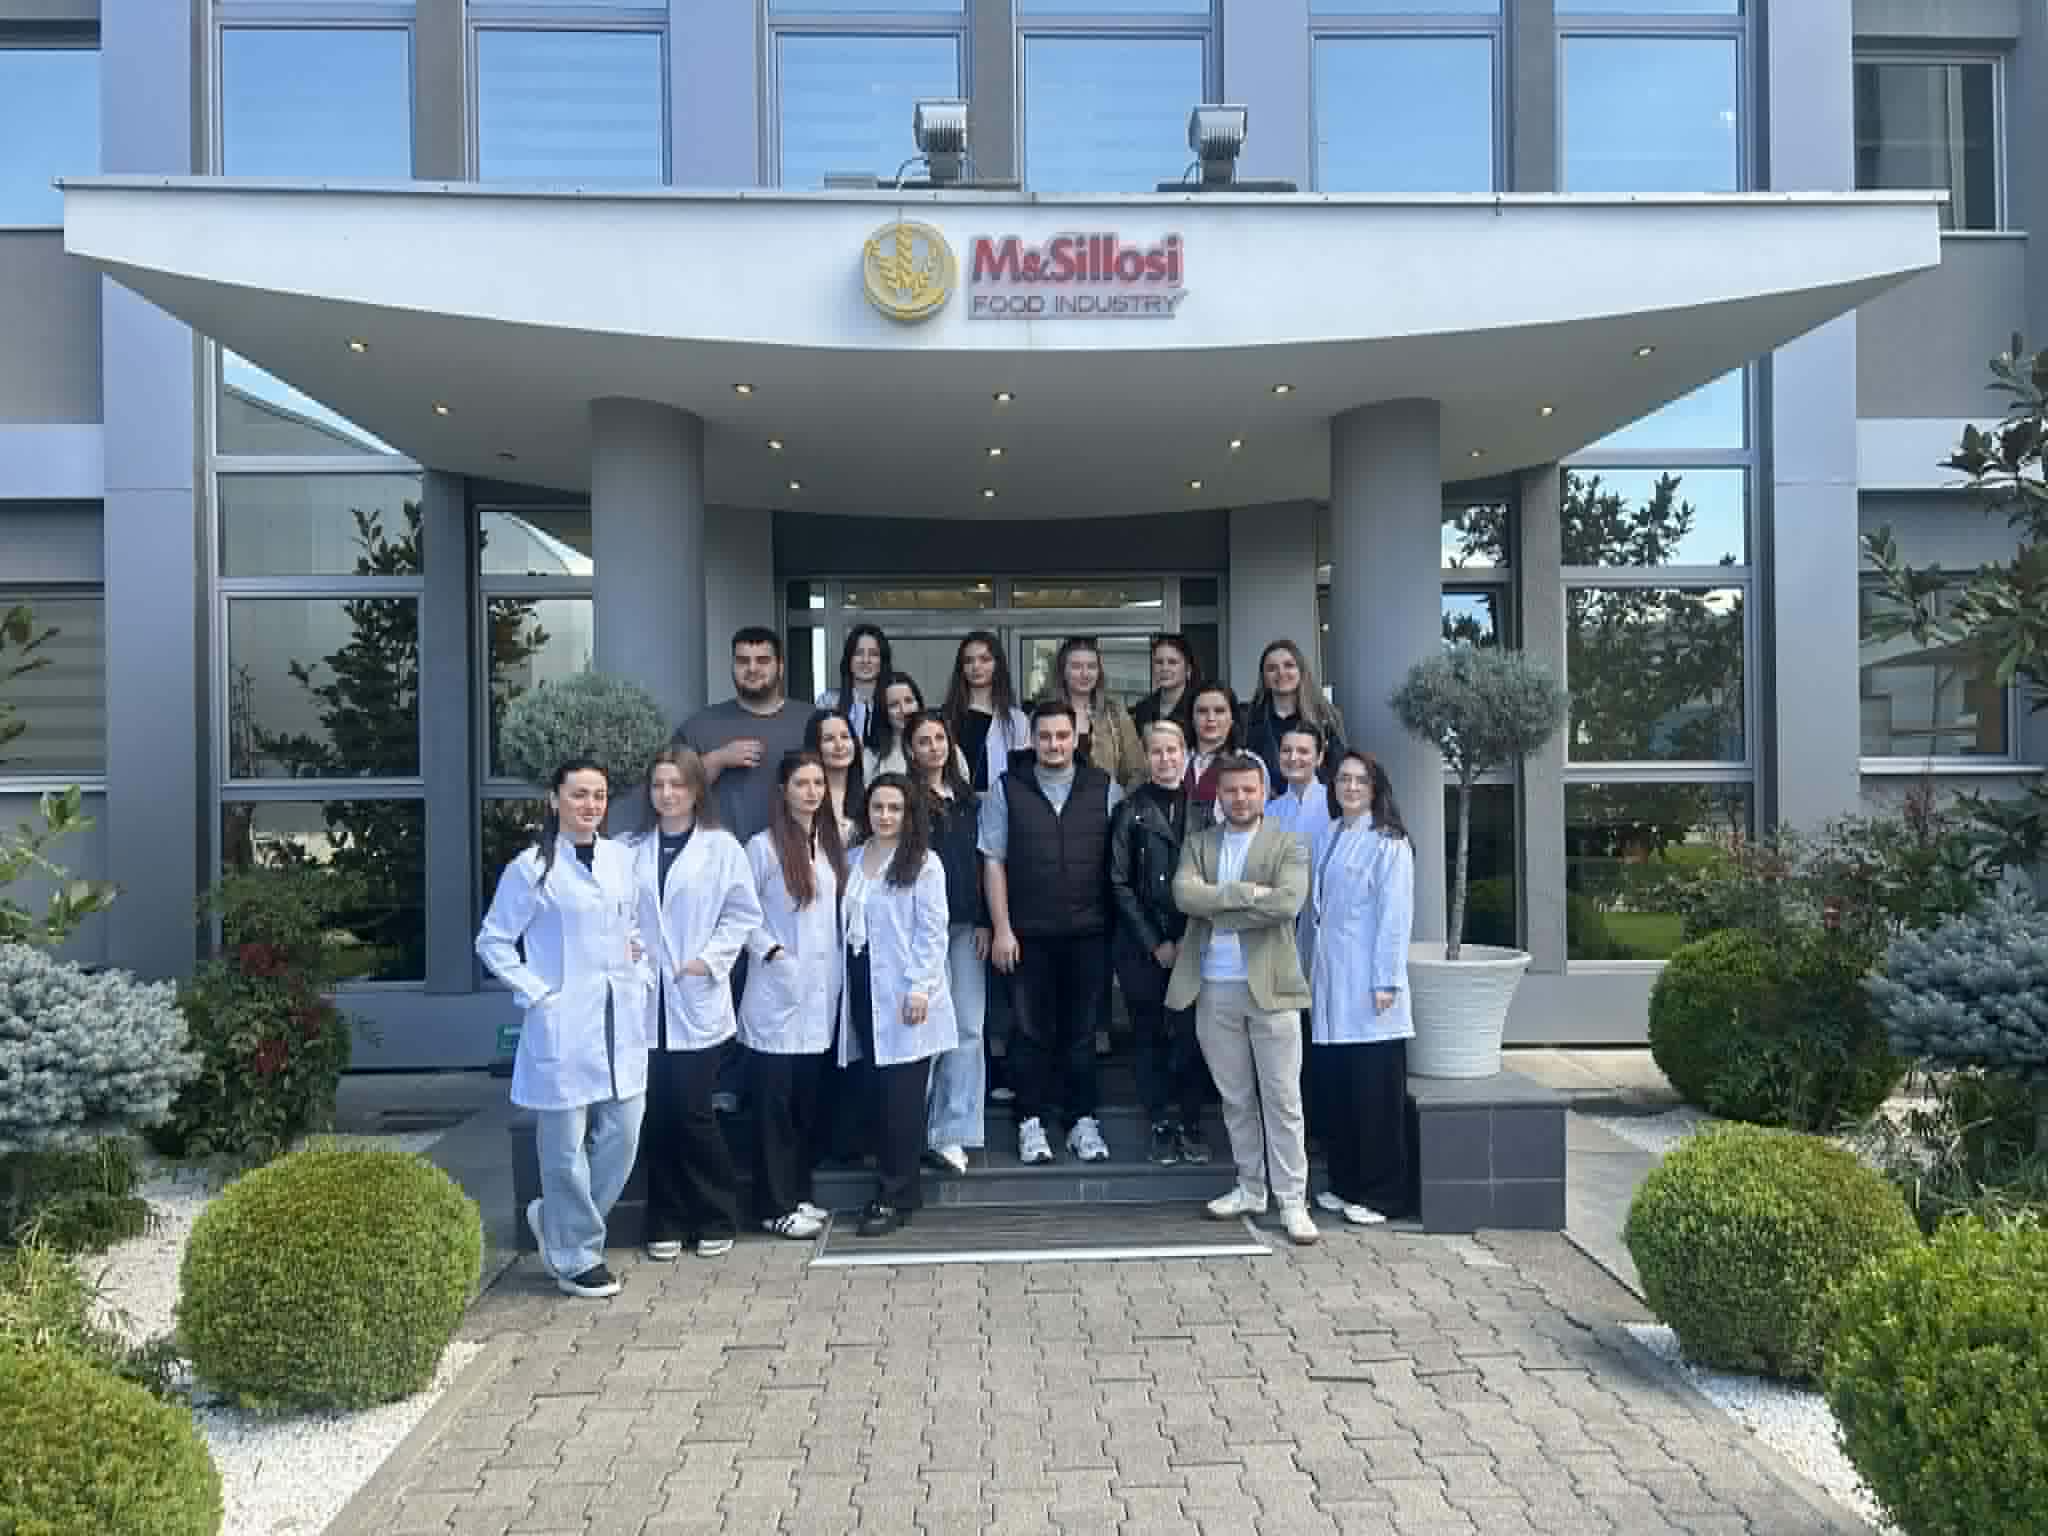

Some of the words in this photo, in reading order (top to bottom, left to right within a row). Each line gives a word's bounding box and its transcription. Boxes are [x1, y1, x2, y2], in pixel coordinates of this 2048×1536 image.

[973, 234, 1180, 282] M&Sillosi
[974, 295, 1044, 313] FOOD
[1055, 295, 1178, 313] INDUSTRY
